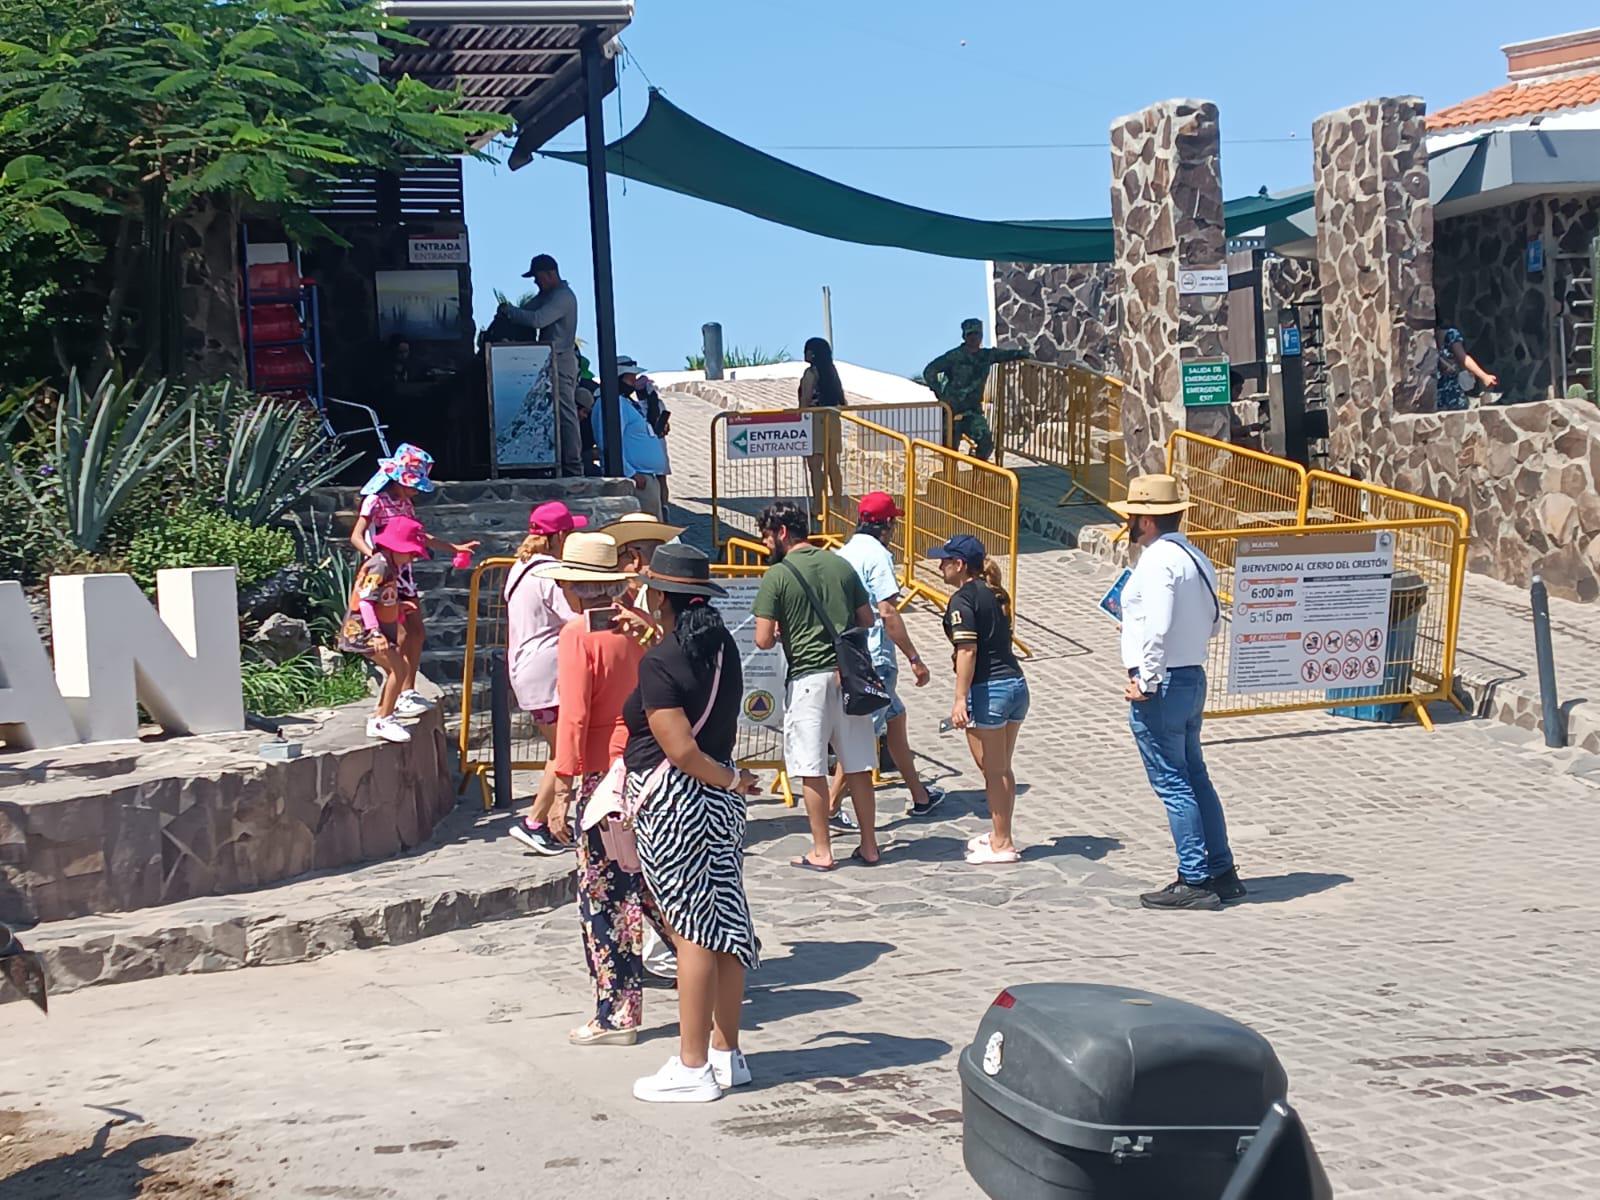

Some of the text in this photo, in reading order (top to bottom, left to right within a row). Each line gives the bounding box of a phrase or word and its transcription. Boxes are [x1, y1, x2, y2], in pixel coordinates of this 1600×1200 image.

[414, 242, 461, 250] ENTRADA
[749, 429, 808, 441] ENTRADA
[750, 441, 809, 453] ENTRANCE
[1241, 557, 1388, 573] BIENVENIDO AL CERRO DEL CRESTÓN
[1251, 587, 1294, 599] 6:00 am
[1275, 612, 1293, 624] pm
